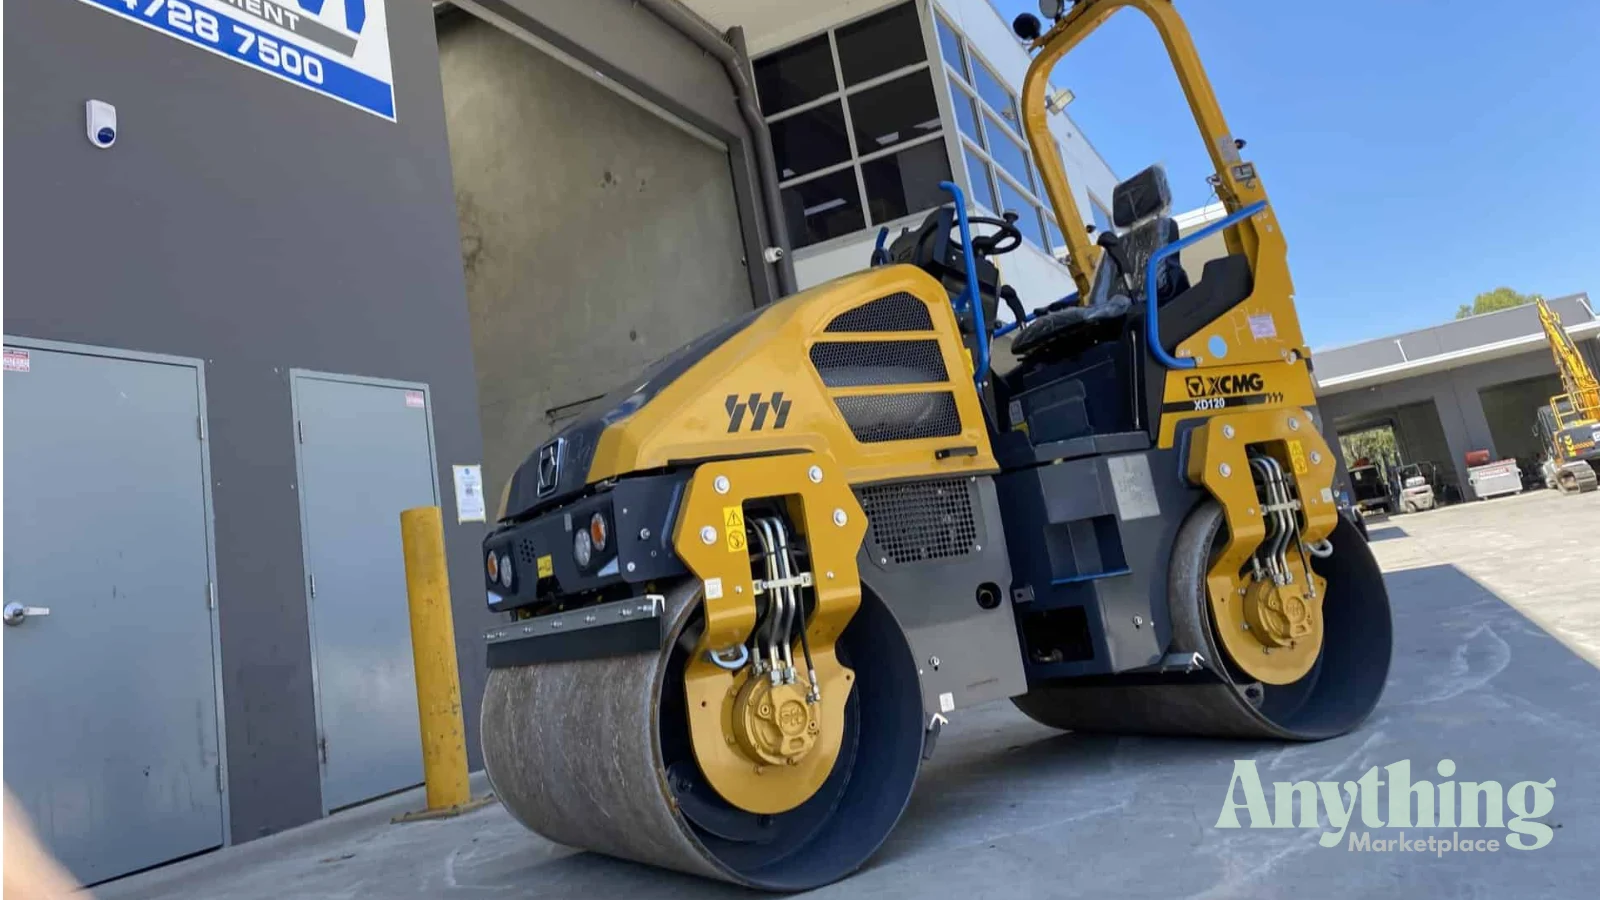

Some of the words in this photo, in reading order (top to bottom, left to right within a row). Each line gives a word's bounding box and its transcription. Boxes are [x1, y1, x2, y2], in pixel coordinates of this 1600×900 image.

[233, 24, 323, 85] 7500
[1206, 373, 1264, 396] XCMG
[1194, 397, 1225, 412] XD120
